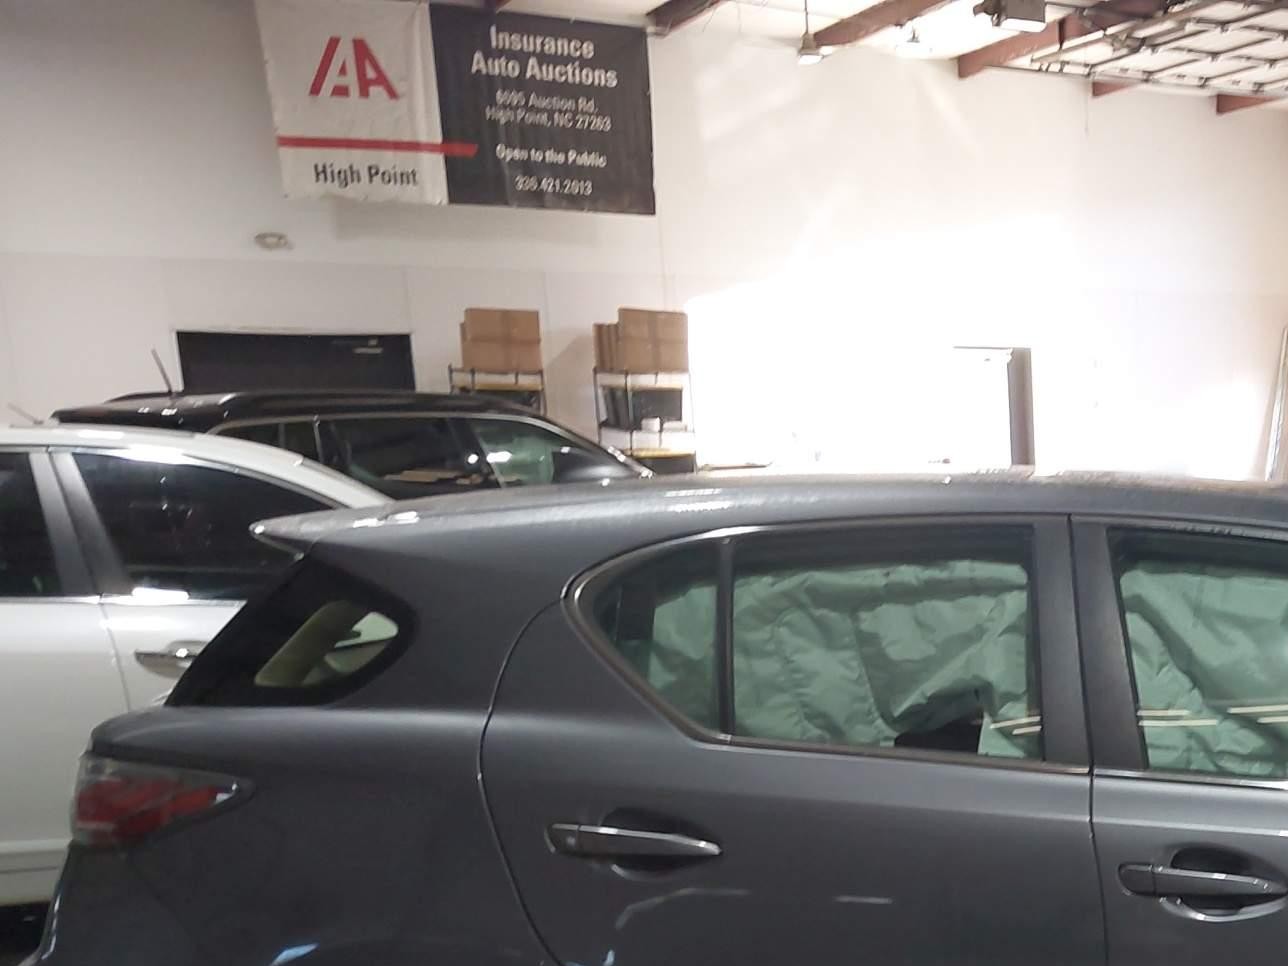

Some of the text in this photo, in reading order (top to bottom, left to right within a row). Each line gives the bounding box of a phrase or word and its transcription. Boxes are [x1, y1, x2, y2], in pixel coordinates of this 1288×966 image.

[489, 24, 595, 59] Insurance
[471, 50, 618, 88] Auto Auctions
[528, 91, 576, 111] Auction
[485, 105, 515, 125] High
[516, 108, 552, 127] Point,
[553, 112, 574, 128] NC
[496, 143, 607, 168] Open to the Public
[314, 163, 417, 188] High Point
